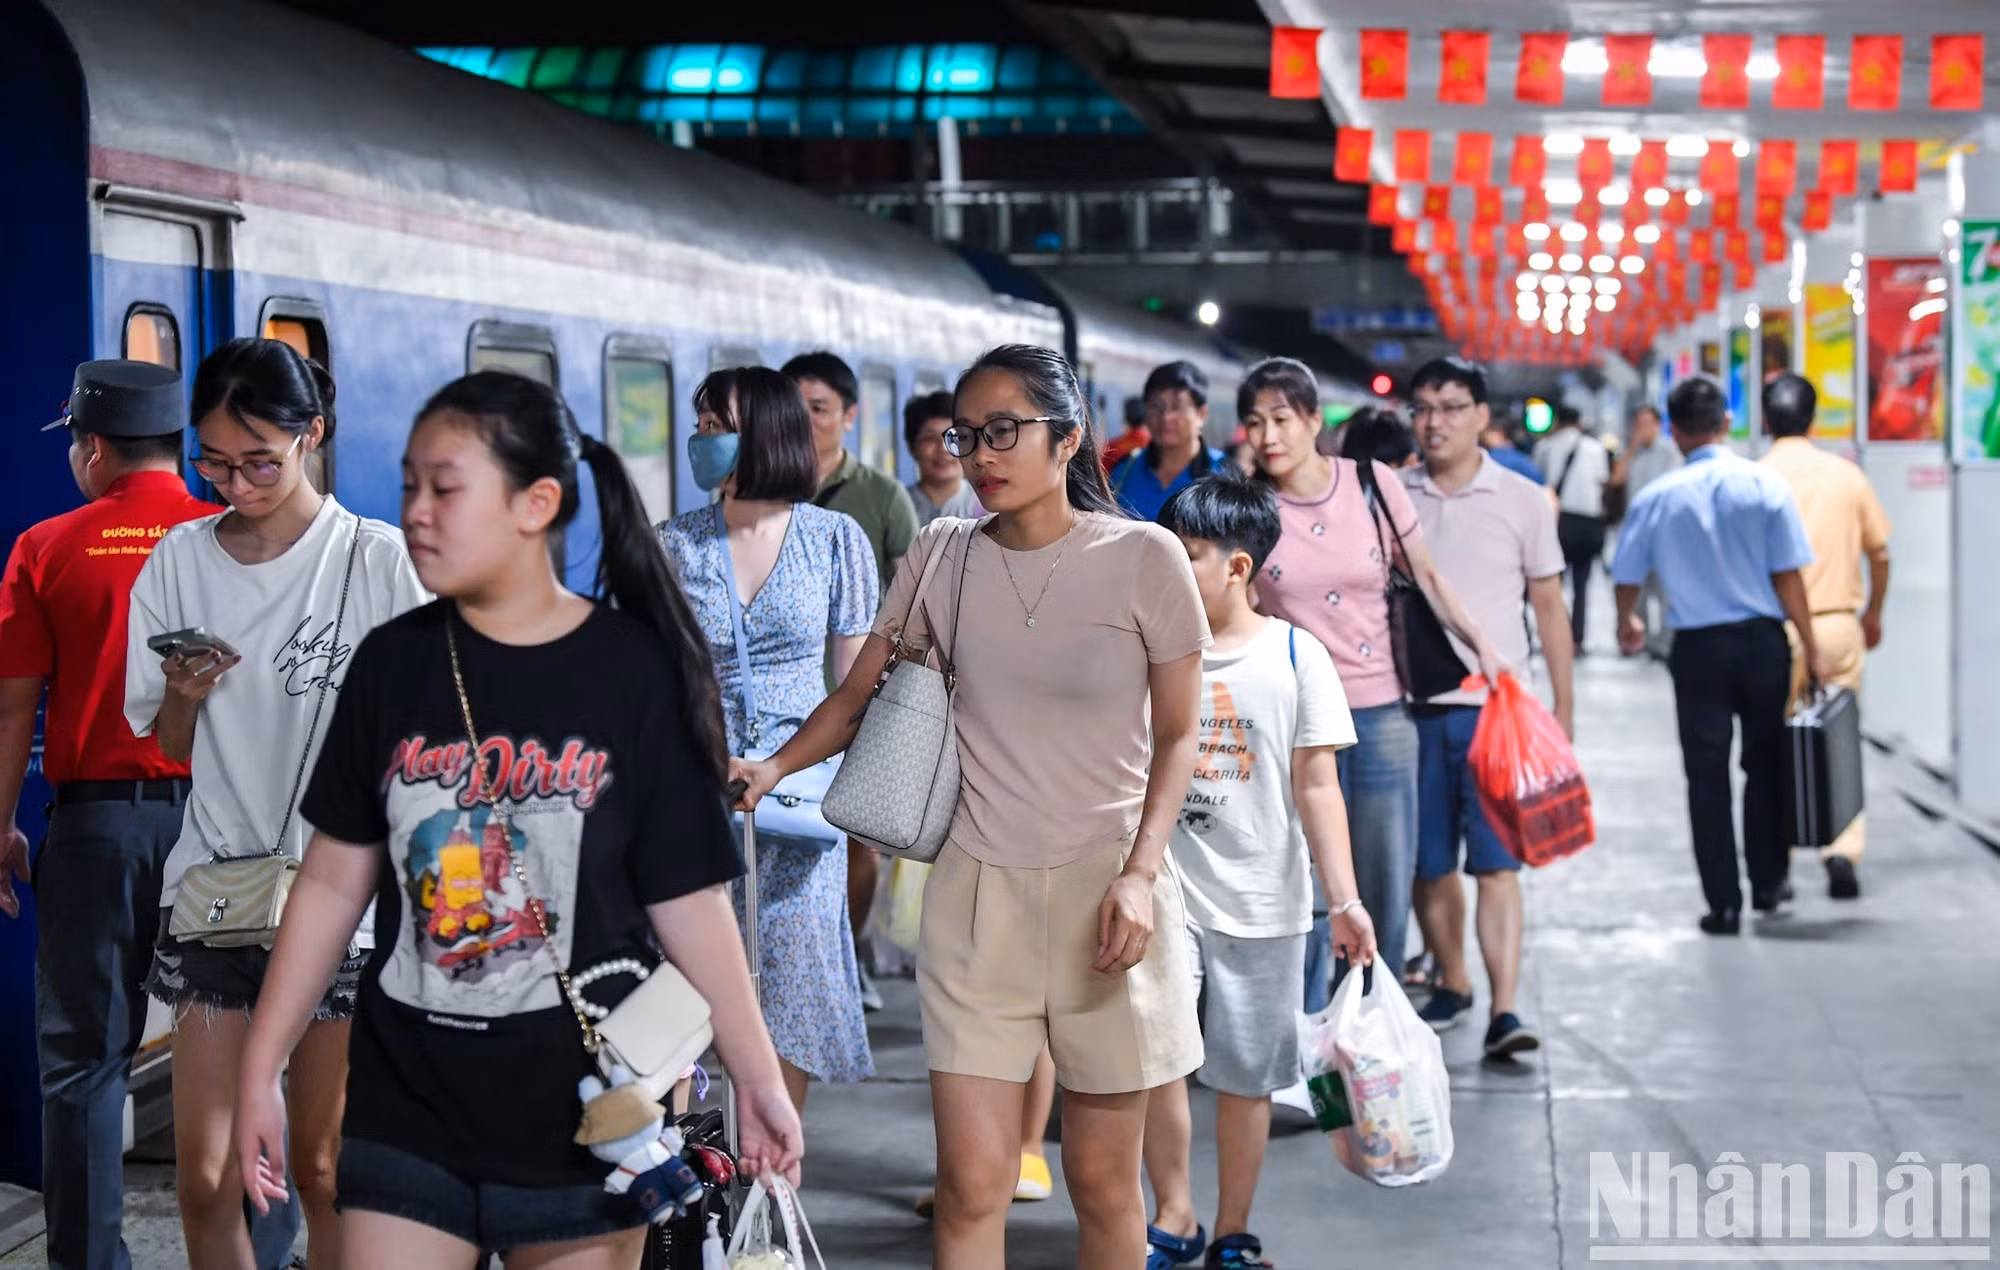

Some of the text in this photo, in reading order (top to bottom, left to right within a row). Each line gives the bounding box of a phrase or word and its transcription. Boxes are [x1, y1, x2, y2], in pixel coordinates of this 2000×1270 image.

[1200, 718, 1254, 729] NGELES
[1198, 742, 1248, 754] BEACH
[381, 735, 613, 809] Play Dirty
[1192, 768, 1250, 781] CLARITA
[1185, 793, 1229, 806] NDALE
